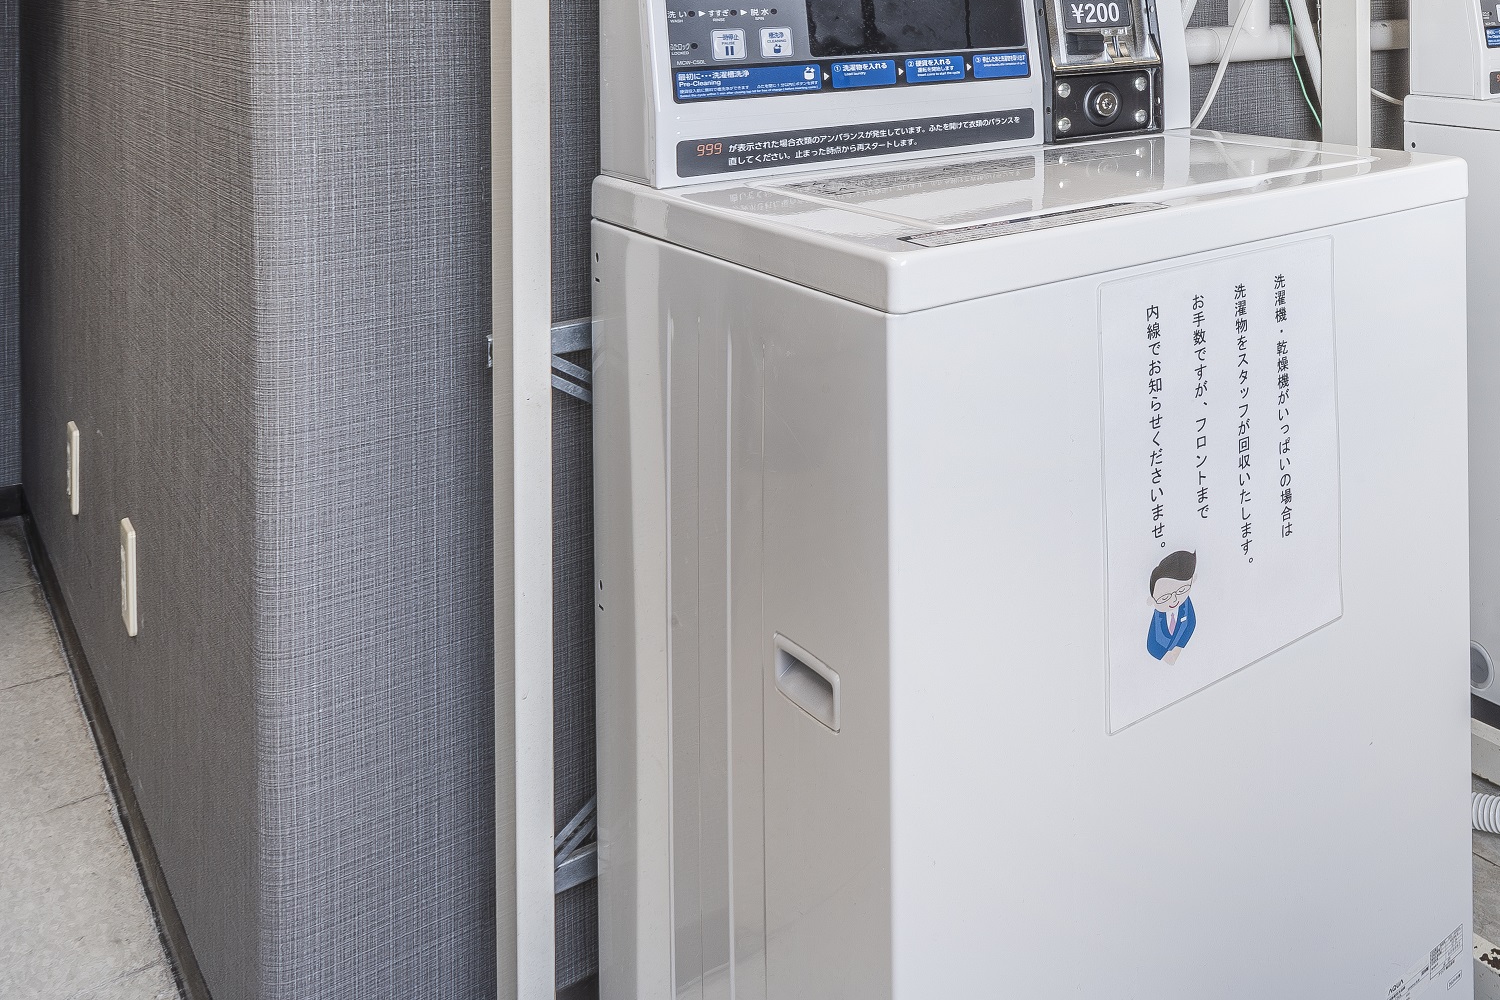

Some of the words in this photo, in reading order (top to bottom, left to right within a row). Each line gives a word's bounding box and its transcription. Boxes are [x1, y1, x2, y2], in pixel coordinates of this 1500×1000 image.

[708, 9, 729, 18] すすぎ
[750, 8, 769, 16] 脱水
[1071, 3, 1120, 23] ¥200
[843, 62, 888, 72] 洗濯物を入れる
[679, 80, 722, 88] Pre-Cleaning
[697, 143, 723, 157] 999
[1192, 294, 1209, 519] お手数ですが、フロントまで
[1274, 274, 1293, 538] 洗濯機・乾燥機がいっぱいの場合は
[1146, 304, 1166, 548] 内線でお知らせくださいませ。
[1234, 283, 1254, 563] 洗濯物をスタッフが回収いたします。
